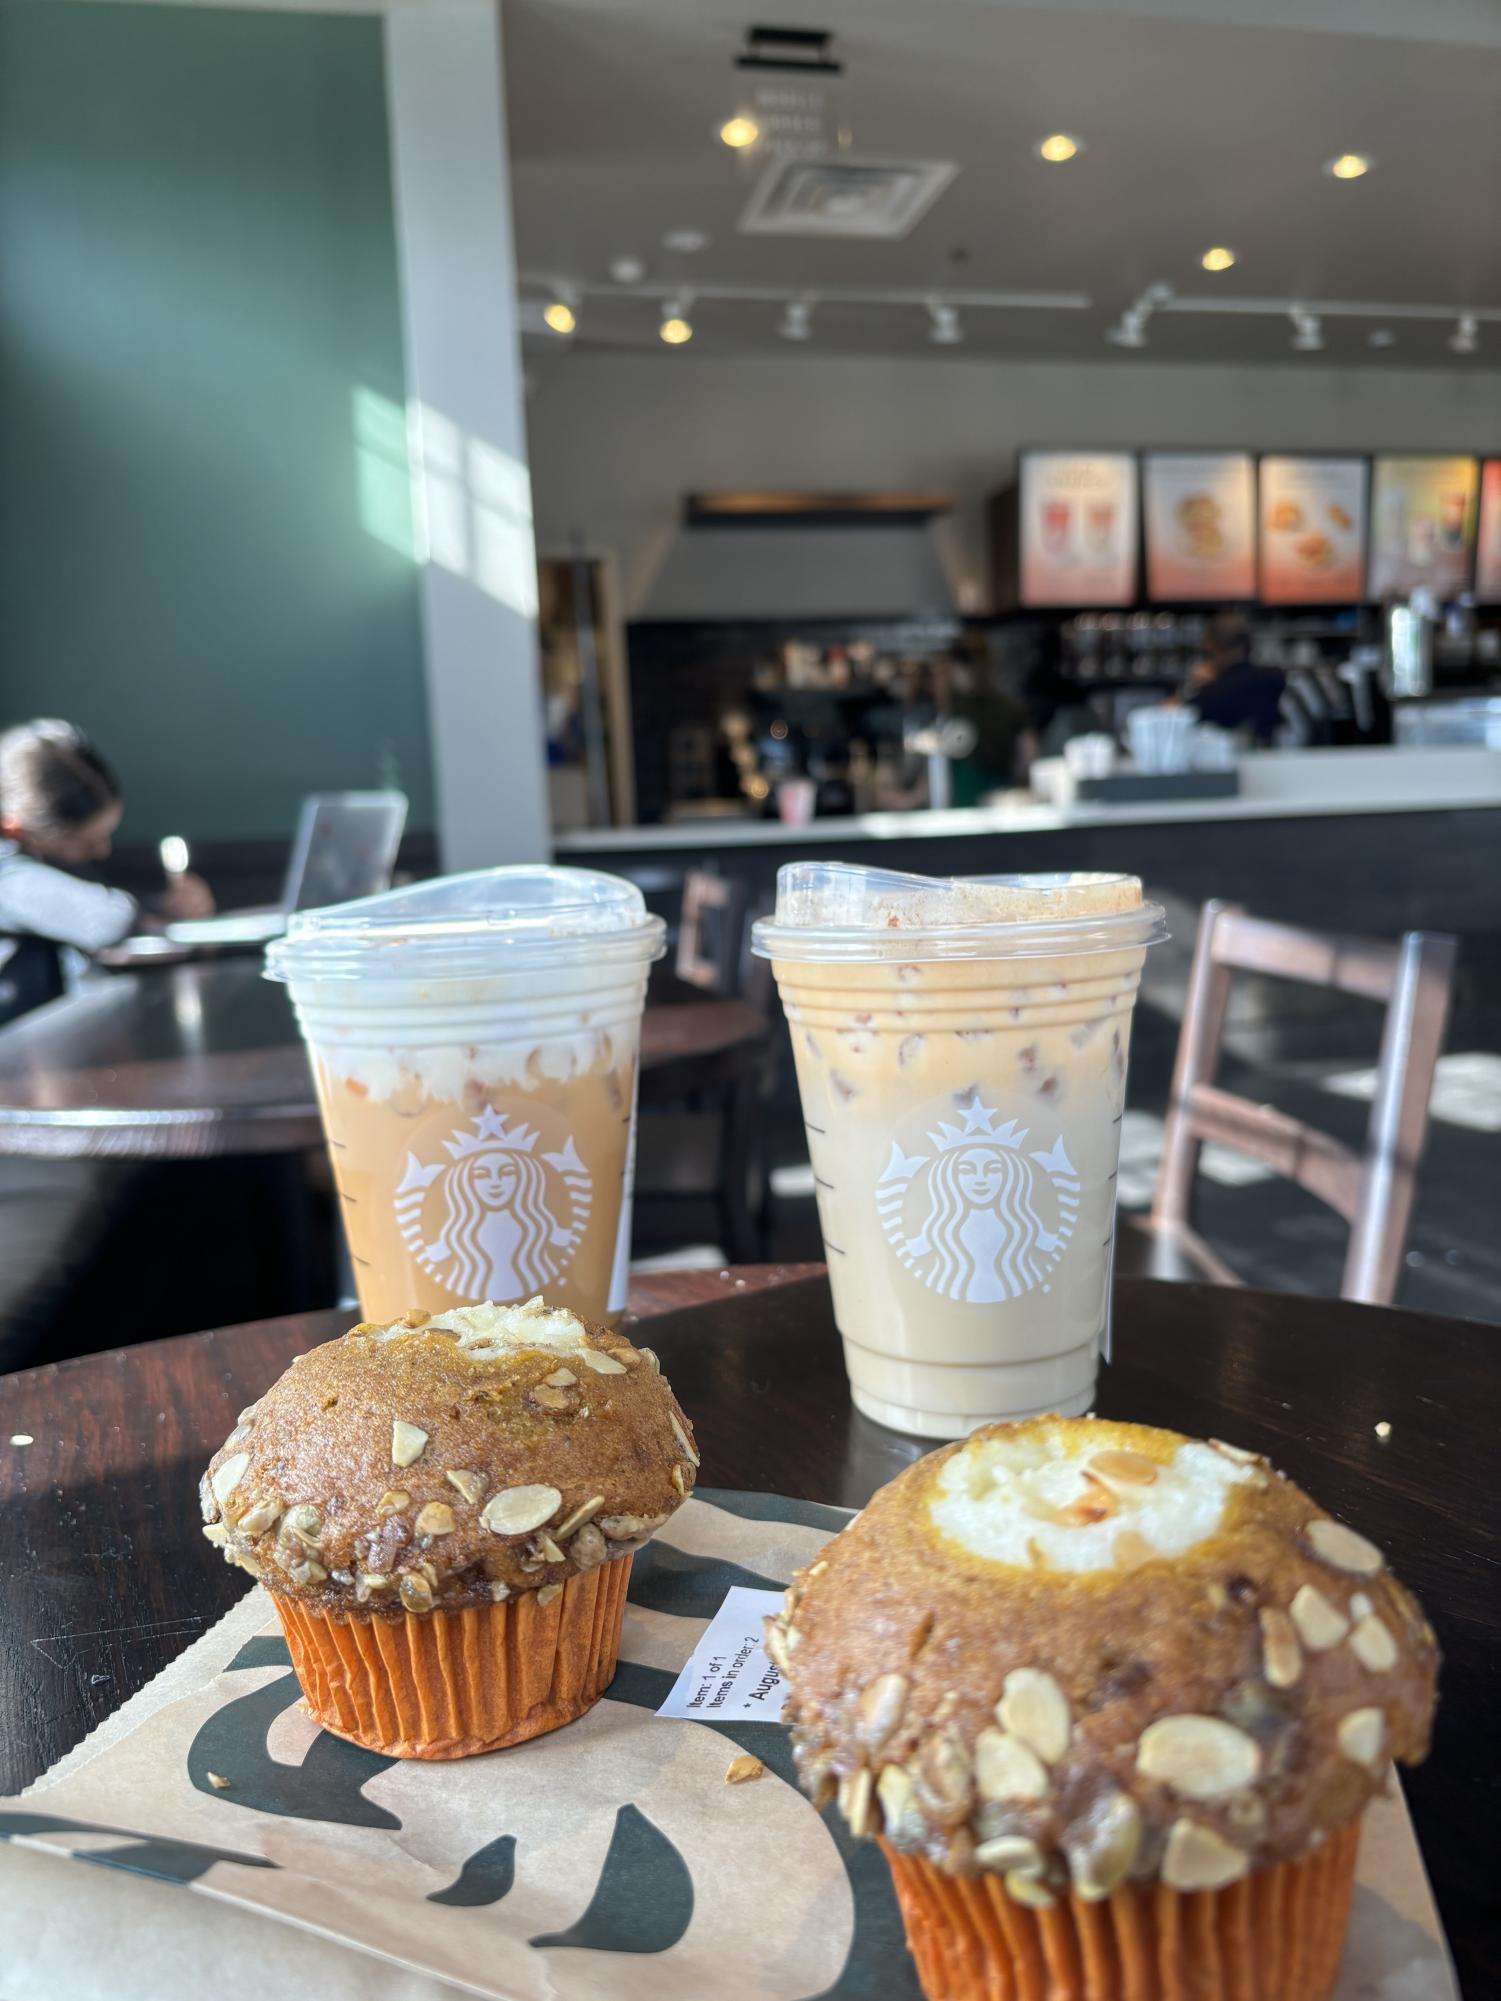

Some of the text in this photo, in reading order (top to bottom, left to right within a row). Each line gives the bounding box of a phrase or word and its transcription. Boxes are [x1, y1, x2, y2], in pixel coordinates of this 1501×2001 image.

[686, 1683, 712, 1708] Item:
[709, 1662, 723, 1673] of
[706, 1681, 733, 1708] Items
[722, 1669, 741, 1679] in
[732, 1643, 754, 1668] order:
[748, 1661, 780, 1701] Augus
